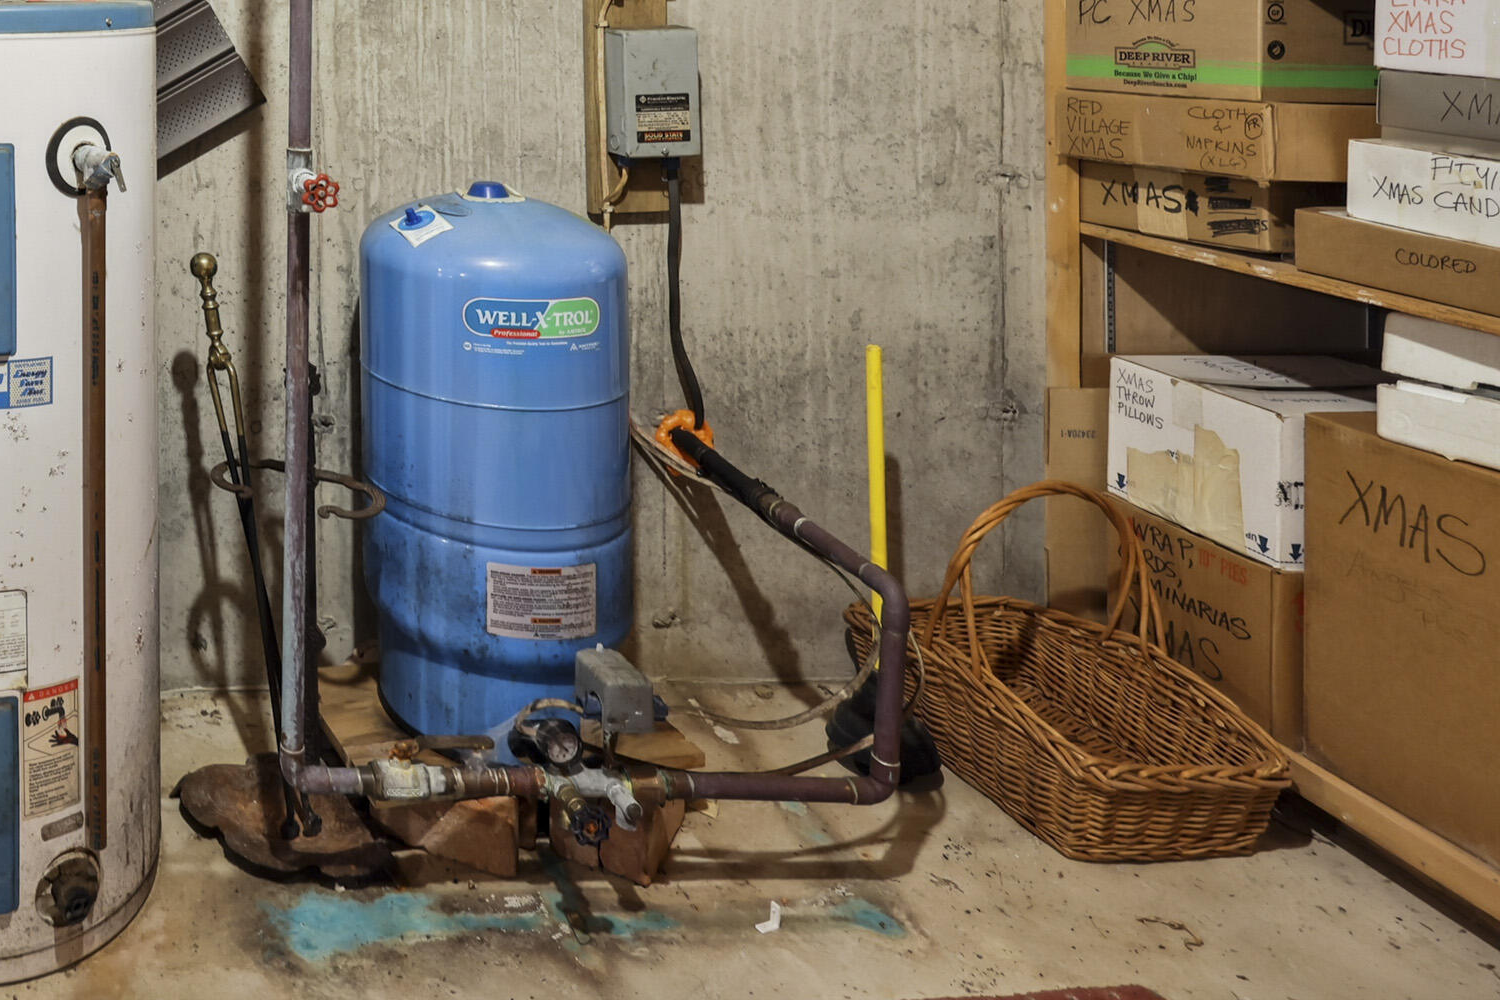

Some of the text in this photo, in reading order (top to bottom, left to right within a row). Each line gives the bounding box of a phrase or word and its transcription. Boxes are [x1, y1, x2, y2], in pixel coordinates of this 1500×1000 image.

[1387, 10, 1455, 35] XMAS
[1119, 50, 1190, 64] DEEP RIVER
[1383, 36, 1467, 61] CLOTHS
[1114, 69, 1141, 78] Because
[1154, 71, 1171, 80] Give
[1178, 72, 1197, 82] Chip!
[1067, 96, 1102, 116] RED
[1440, 89, 1500, 125] XM
[1066, 115, 1132, 137] VILLAGE
[1067, 134, 1125, 159] XMAS
[1186, 135, 1257, 157] NAPKINS
[1100, 179, 1185, 214] XMAS
[1373, 175, 1424, 208] XMAS
[1395, 247, 1477, 275] COLORED
[493, 329, 538, 338] Professional
[1117, 367, 1155, 393] XMAS
[1116, 384, 1156, 410] THROW
[1117, 401, 1164, 430] PILLOWS
[1339, 470, 1486, 577] XMAS
